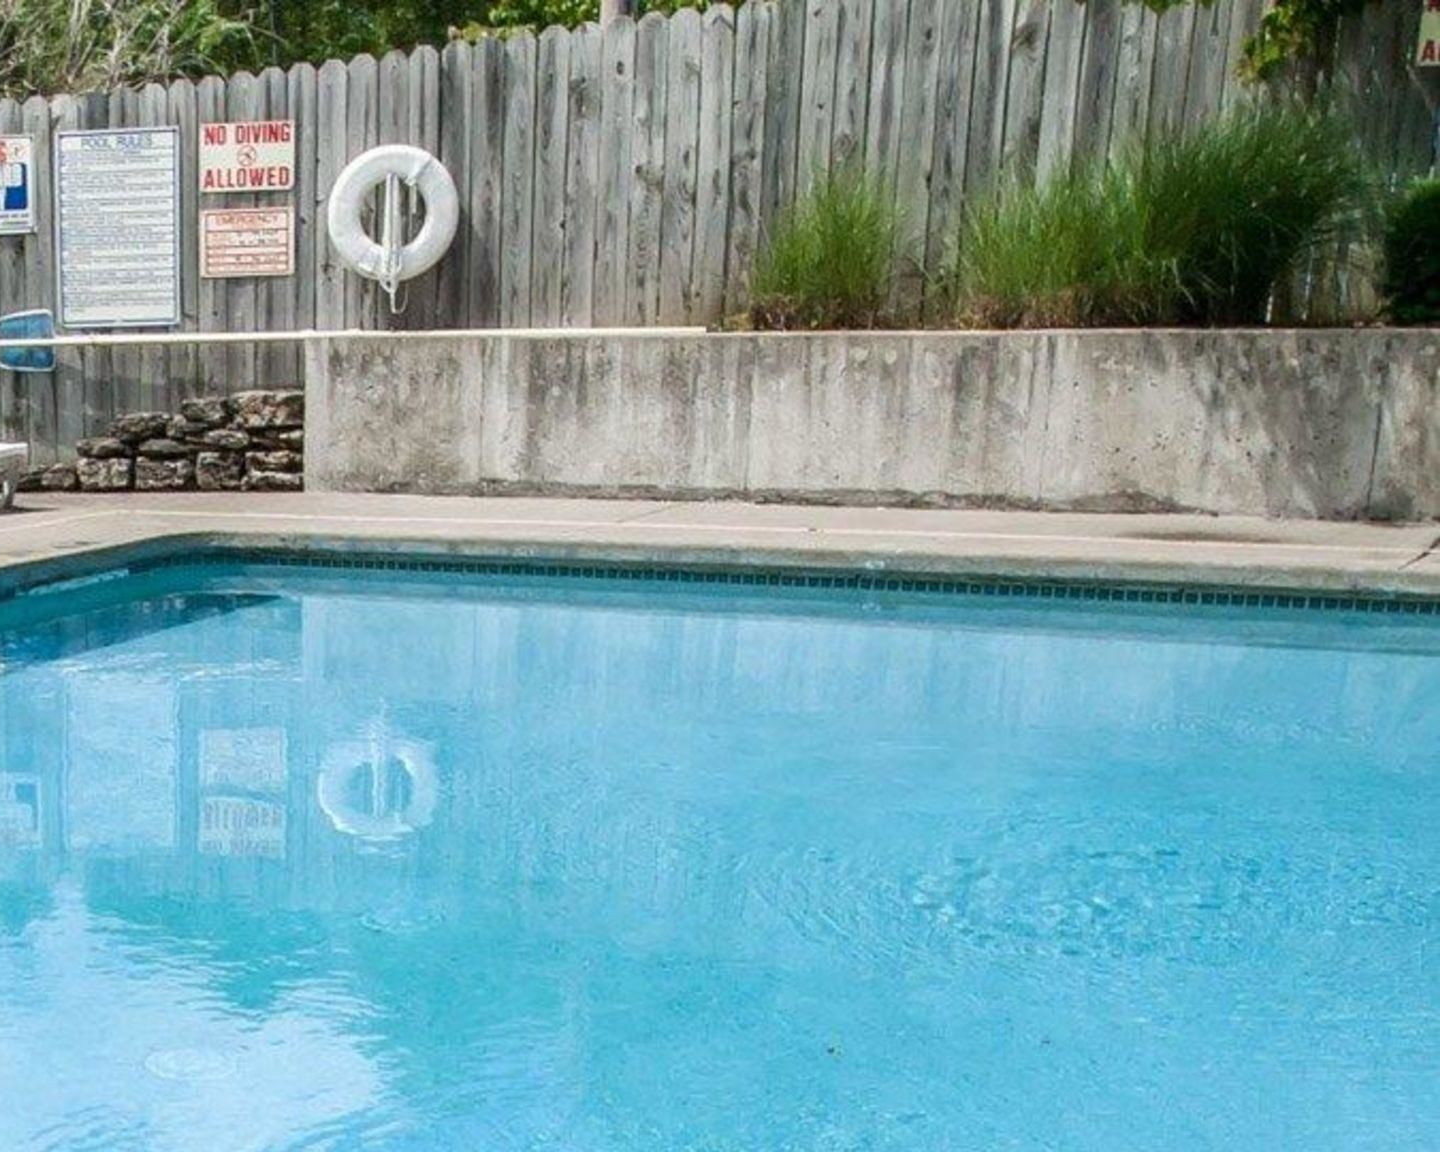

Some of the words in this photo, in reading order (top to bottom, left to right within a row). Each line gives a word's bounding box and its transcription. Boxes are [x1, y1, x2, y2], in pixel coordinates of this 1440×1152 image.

[80, 136, 112, 150] POOL
[116, 133, 153, 149] RULES
[204, 125, 227, 146] NO
[235, 123, 291, 145] DIVING
[203, 166, 290, 189] ALLOWED
